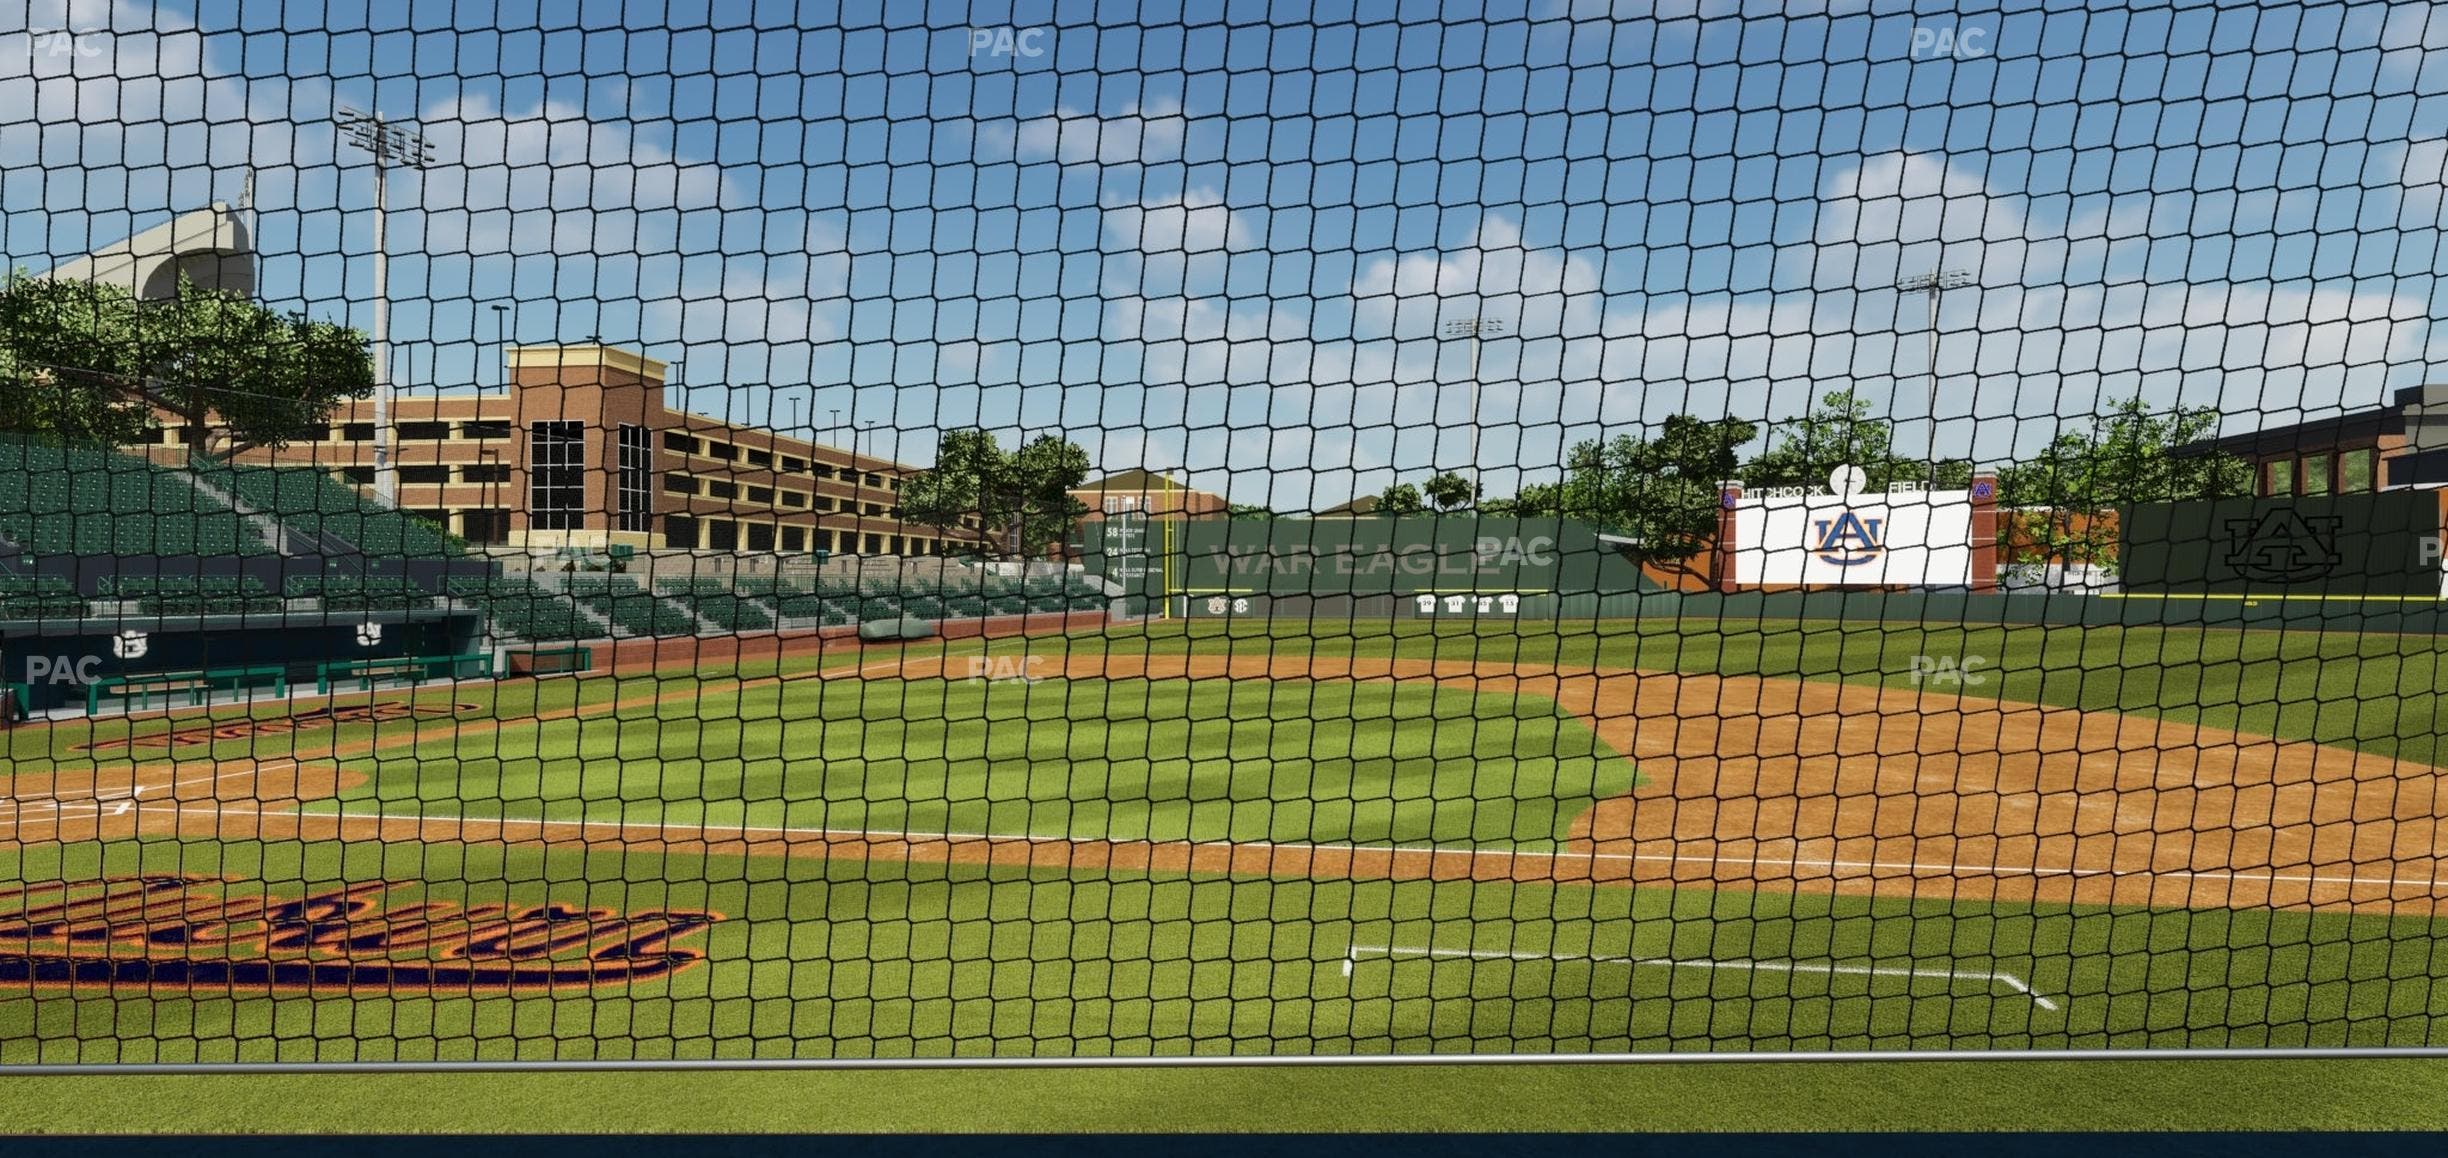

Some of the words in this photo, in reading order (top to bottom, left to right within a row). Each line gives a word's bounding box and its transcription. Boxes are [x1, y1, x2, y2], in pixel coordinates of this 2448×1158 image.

[1107, 527, 1118, 537] 58
[1210, 544, 1320, 575] WAR
[1336, 543, 1502, 575] EAGLE
